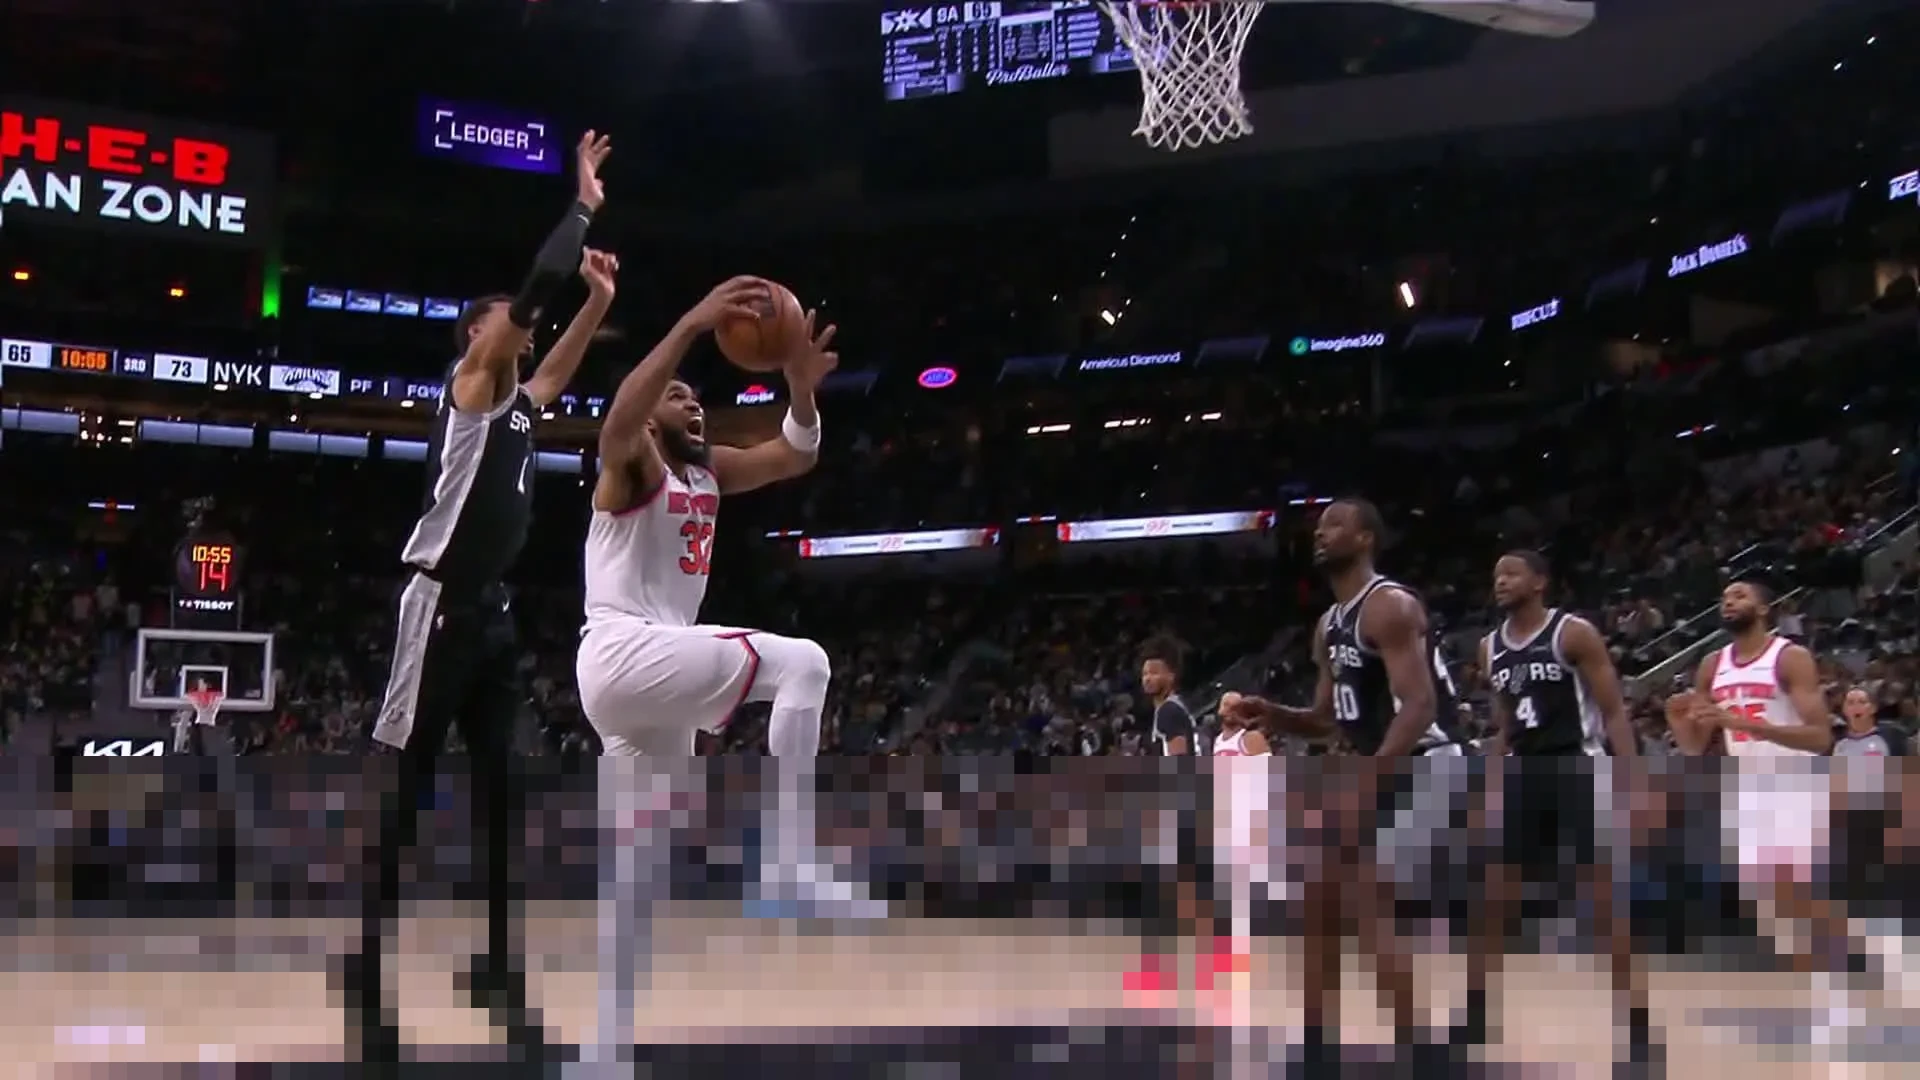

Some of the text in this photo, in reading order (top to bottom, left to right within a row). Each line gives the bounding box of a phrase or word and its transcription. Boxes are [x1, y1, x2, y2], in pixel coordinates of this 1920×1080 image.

[450, 121, 529, 149] LEDGER
[100, 179, 247, 233] ZONE
[8, 343, 31, 363] 65
[1129, 351, 1181, 366] Diamond
[123, 356, 146, 372] 3RD
[170, 360, 192, 378] 73
[213, 361, 262, 385] NYK
[350, 379, 372, 393] PF
[193, 544, 232, 563] 10:55
[200, 561, 227, 591] 14
[193, 600, 234, 610] TISSOT
[1515, 696, 1539, 729] 4
